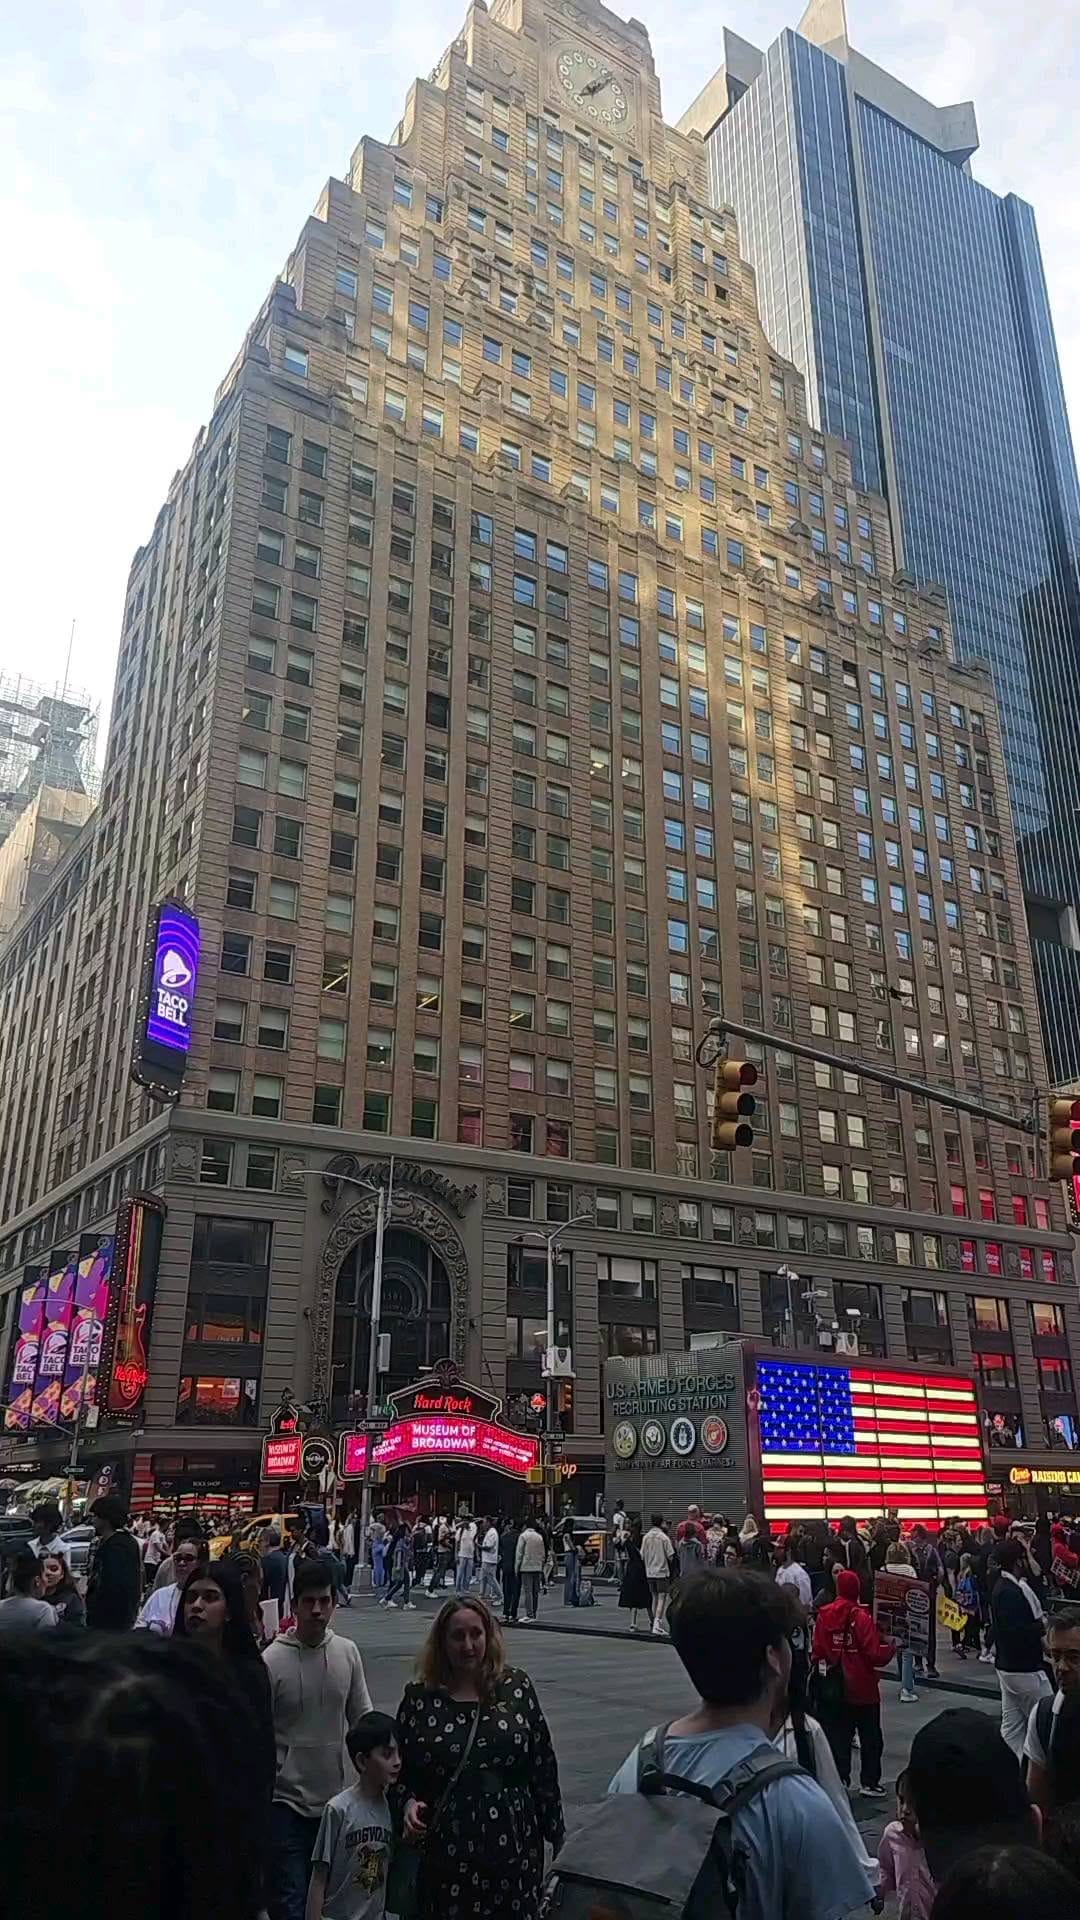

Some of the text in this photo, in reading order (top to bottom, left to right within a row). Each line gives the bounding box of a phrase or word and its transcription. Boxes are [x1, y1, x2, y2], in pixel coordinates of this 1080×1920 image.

[157, 987, 188, 1013] TACO
[157, 1002, 187, 1027] BELL
[629, 1378, 676, 1397] ARMED
[678, 1374, 736, 1393] FORCES
[413, 1393, 443, 1410] Hard
[443, 1395, 473, 1414] Rock
[612, 1394, 727, 1415] RECRUITING STATION
[411, 1424, 476, 1436] MUSEUM OF
[267, 1444, 289, 1456] MUSEUM
[411, 1437, 477, 1449] BROADWAY
[267, 1455, 296, 1468] BROADWAY
[1031, 1470, 1067, 1483] RAISING
